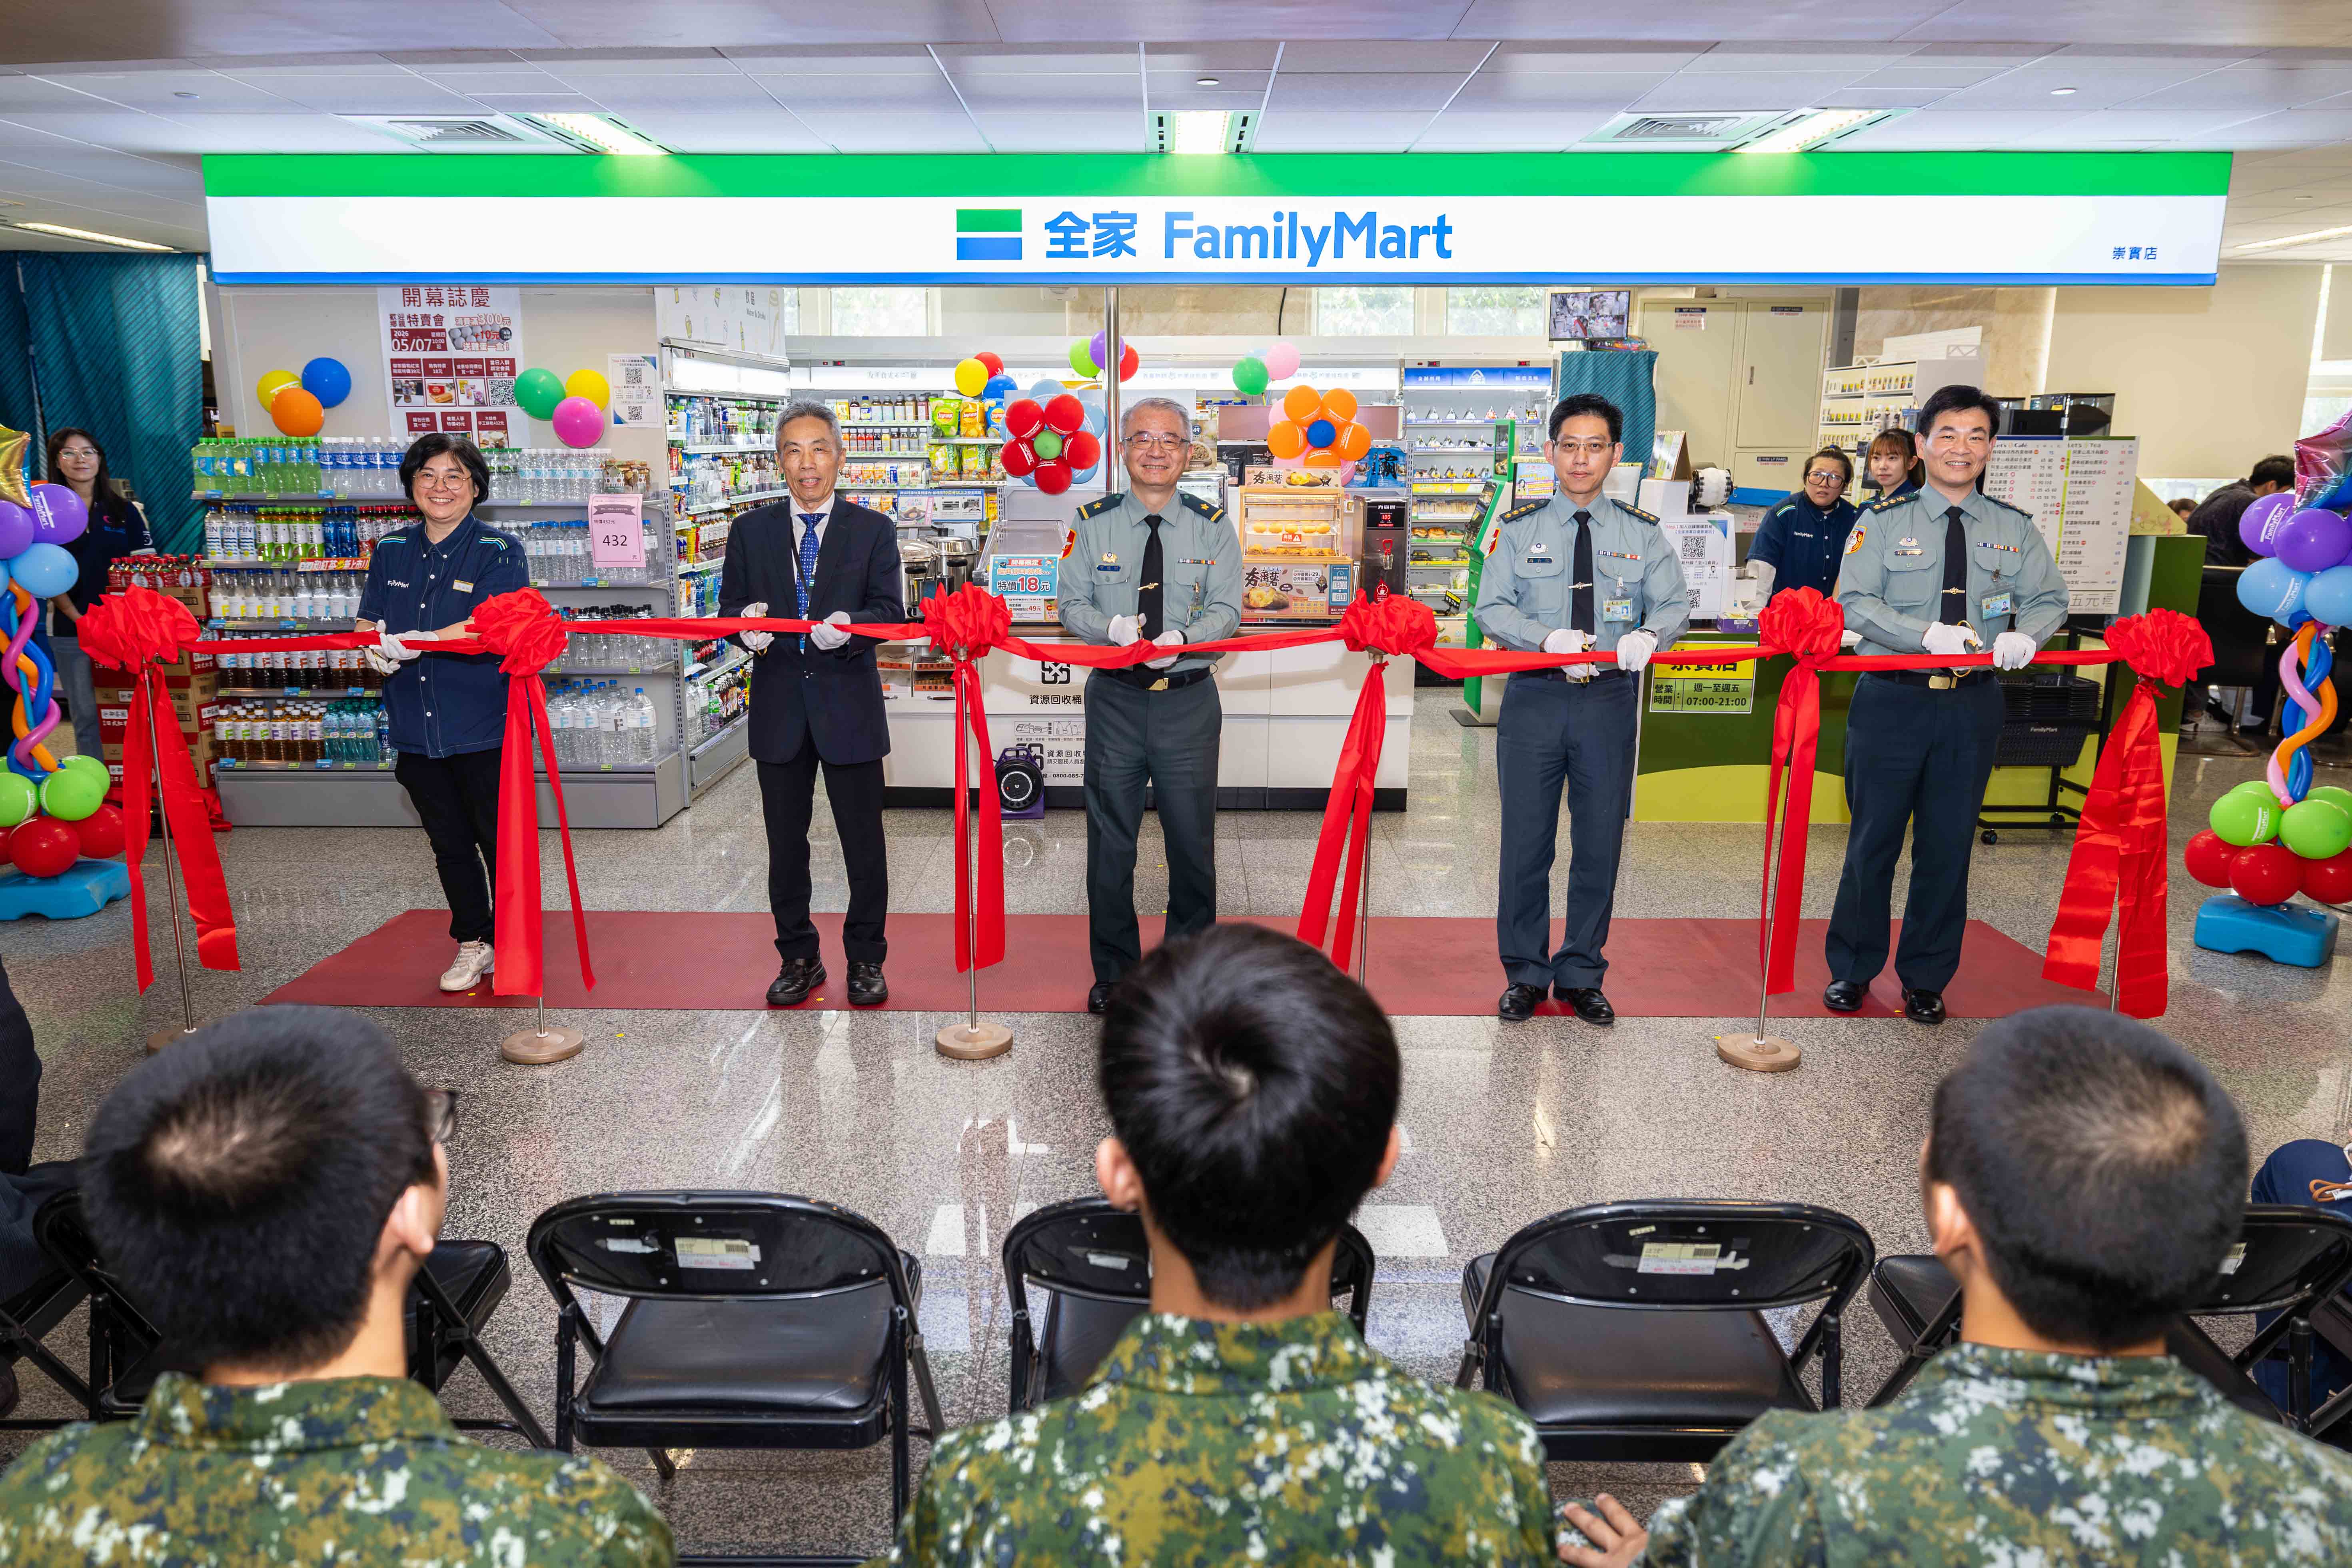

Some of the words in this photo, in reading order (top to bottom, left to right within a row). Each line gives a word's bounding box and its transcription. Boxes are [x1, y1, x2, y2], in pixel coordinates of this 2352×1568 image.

[1044, 211, 1137, 259] 全家
[1165, 211, 1453, 268] FamilyMart
[2112, 246, 2157, 260] 崇實店
[402, 287, 490, 308] 開幕誌慶
[407, 314, 445, 327] 特賣會
[475, 330, 499, 340] +10元
[391, 339, 432, 352] 05/07
[1253, 471, 1283, 484] 夯番薯
[34, 495, 50, 526] FamilyMart
[2264, 506, 2286, 541] FamilyMart
[602, 535, 627, 546] 432
[997, 576, 1051, 591] 特價18元
[1244, 567, 1280, 587] 夯番薯
[2281, 581, 2301, 611] FamilyMart
[1655, 684, 1673, 694] 營業
[1693, 683, 1740, 693] 週一至週五
[1029, 695, 1082, 705] 資源回收桶
[1654, 695, 1672, 704] 時間
[1686, 697, 1747, 707] 07:00-21:00
